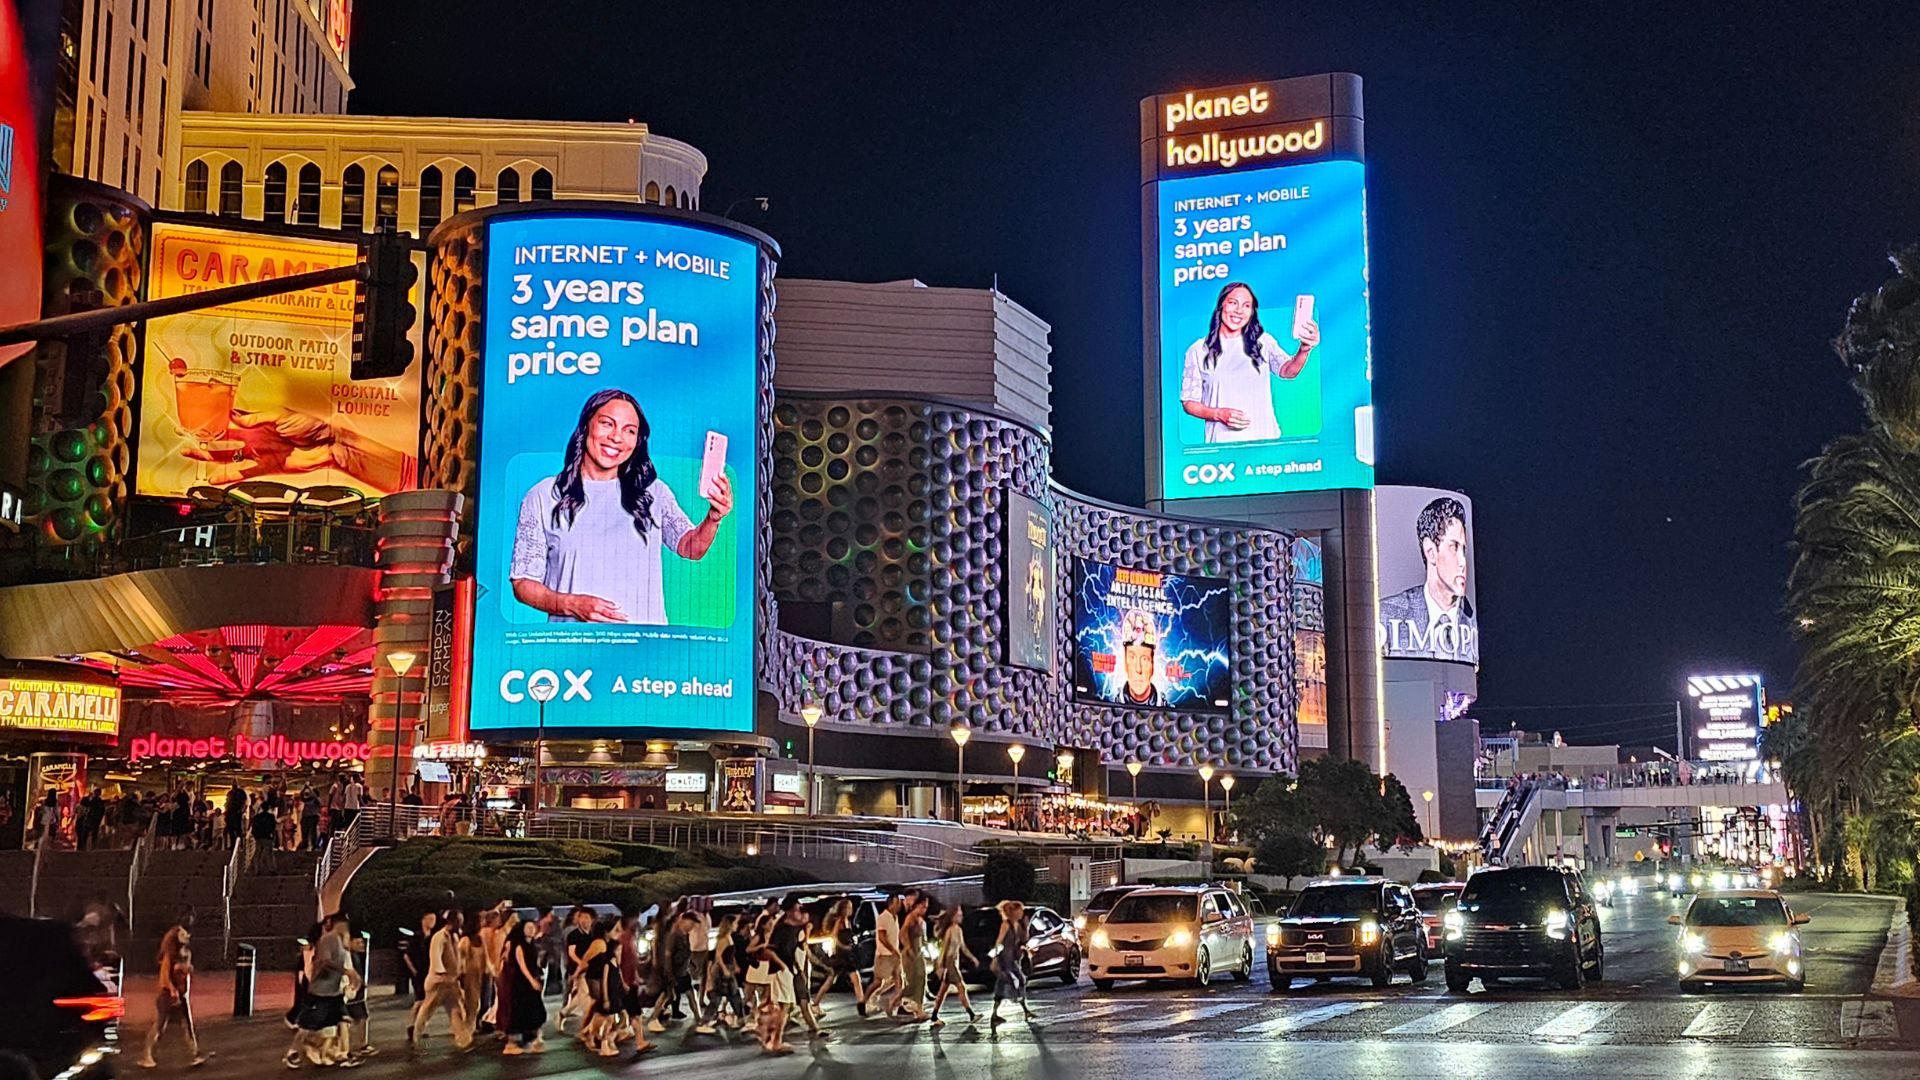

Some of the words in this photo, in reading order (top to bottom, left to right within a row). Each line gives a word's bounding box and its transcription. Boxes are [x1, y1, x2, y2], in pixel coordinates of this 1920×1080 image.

[1166, 87, 1269, 132] planet
[1166, 122, 1323, 167] hollywood
[1174, 194, 1241, 213] INTERNET
[1257, 186, 1310, 205] MOBILE
[1174, 218, 1187, 237] 3
[1193, 214, 1251, 239] years
[1174, 240, 1232, 260] same
[1238, 231, 1287, 257] plan
[514, 245, 628, 265] INTERNET
[656, 249, 731, 280] MOBILE
[1173, 259, 1229, 287] price
[511, 274, 533, 305] 3
[542, 276, 644, 310] years
[510, 314, 609, 340] same
[622, 308, 698, 346] plan
[229, 332, 293, 351] OUTDOOR
[298, 339, 338, 355] PATIO
[230, 351, 240, 365] &
[245, 352, 285, 367] STRIP
[290, 355, 335, 371] VIEWS
[507, 341, 601, 384] price
[331, 383, 399, 401] COCKTAIL
[337, 401, 391, 417] LOUNGE
[1182, 462, 1236, 485] COX
[1255, 464, 1282, 477] step
[1284, 459, 1323, 474] ahead
[1106, 593, 1174, 615] INTELLIGENCE
[1110, 580, 1167, 601] ARTIFICIAL
[432, 609, 444, 687] GORDON
[441, 610, 453, 686] RAMSAY
[500, 669, 593, 703] COX
[611, 676, 628, 694] A
[632, 676, 677, 698] step
[681, 677, 733, 698] ahead
[0, 690, 118, 722] CARAMELLA
[1, 716, 41, 727] ITALIAN
[42, 717, 91, 730] RESTAURANT
[130, 732, 226, 763] planet
[439, 743, 487, 759] ZEBRA
